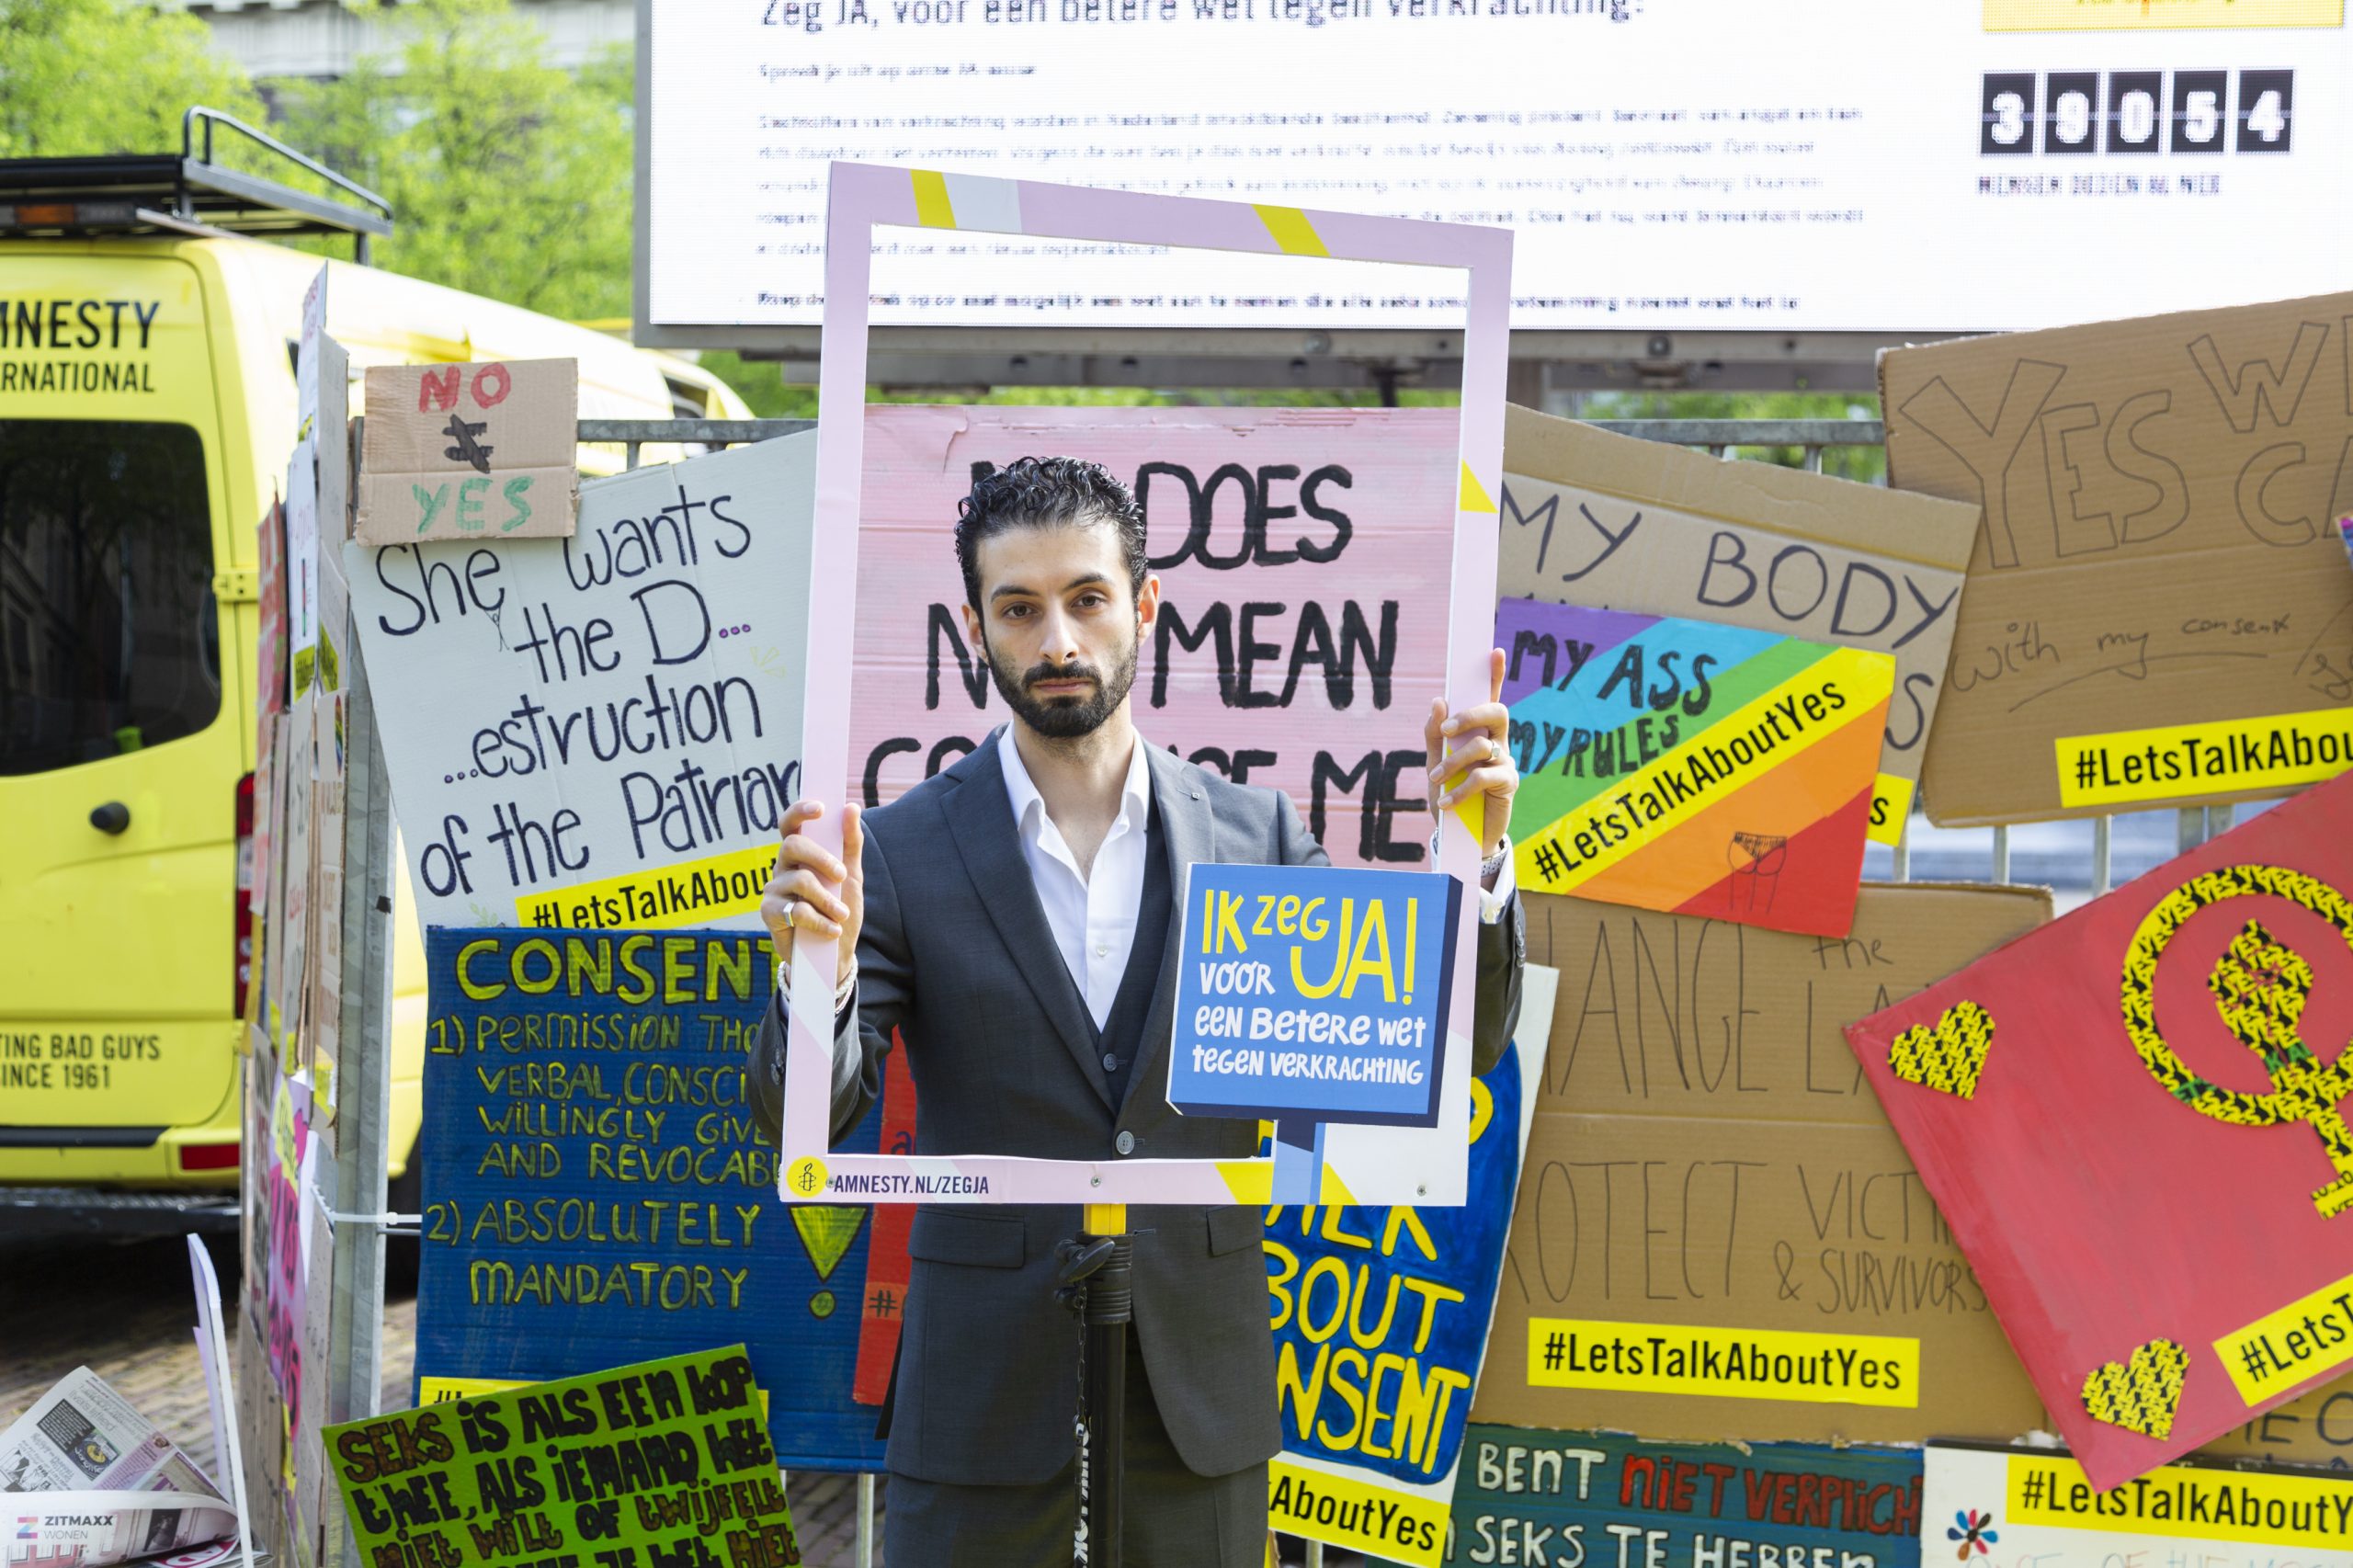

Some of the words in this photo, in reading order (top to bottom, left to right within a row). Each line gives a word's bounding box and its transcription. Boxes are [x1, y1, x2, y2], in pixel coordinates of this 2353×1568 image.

[893, 0, 969, 26] voor
[985, 0, 1046, 24] een
[1061, 0, 1177, 23] betere
[1195, 0, 1254, 21] wet
[1272, 0, 1370, 28] tegen
[1990, 88, 2286, 145] 39054
[418, 362, 511, 413] NO
[1898, 357, 2190, 570] YES
[2186, 315, 2353, 434] W
[412, 475, 535, 535] YES
[1134, 460, 1353, 571] DOES
[375, 542, 506, 636] She
[562, 484, 751, 591] wants
[1499, 480, 1643, 583] MY
[1696, 531, 1960, 650] BODY
[514, 602, 620, 683] the
[1151, 600, 1399, 711] MEAN
[2097, 631, 2150, 680] my
[1508, 630, 1595, 691] MY
[1596, 644, 1718, 717] ASS
[1311, 749, 1427, 864] ME
[1534, 682, 1847, 885] #LetsTalkAboutYes
[420, 814, 473, 897] of
[487, 801, 590, 886] the
[620, 757, 801, 860] Patriar
[533, 858, 777, 927] #LetsTalkAbou
[456, 934, 782, 1007] CONSENT
[1201, 889, 1248, 954] IK
[1290, 897, 1418, 1006] JA!
[1812, 936, 1894, 971] the
[1547, 906, 1769, 1098] ANGE
[0, 1034, 41, 1059] ING
[51, 1035, 93, 1059] BAD
[102, 1035, 161, 1059] GUYS
[428, 1015, 467, 1056] 1)
[64, 1064, 110, 1088] 1961
[476, 1142, 562, 1180] AND
[833, 1175, 990, 1195] AMNESTY.NL/ZEGJA
[426, 1202, 462, 1247] 2)
[1798, 1164, 1949, 1245] VICTI
[469, 1260, 750, 1312] MANDATORY
[1773, 1240, 1803, 1302] &
[1816, 1247, 1989, 1316] SURVIVORS
[1543, 1331, 1903, 1392] #LetsTalkAboutYes
[336, 1411, 456, 1484] SEKS
[518, 1387, 599, 1446] ALS
[685, 1356, 753, 1417] KOP
[473, 1455, 548, 1516] ALS
[43, 1529, 89, 1540] WONEN
[44, 1515, 113, 1527] ZITMAXX
[574, 1498, 622, 1541] OF
[1468, 1513, 1586, 1567] SEKS
[1605, 1523, 1670, 1568] TE
